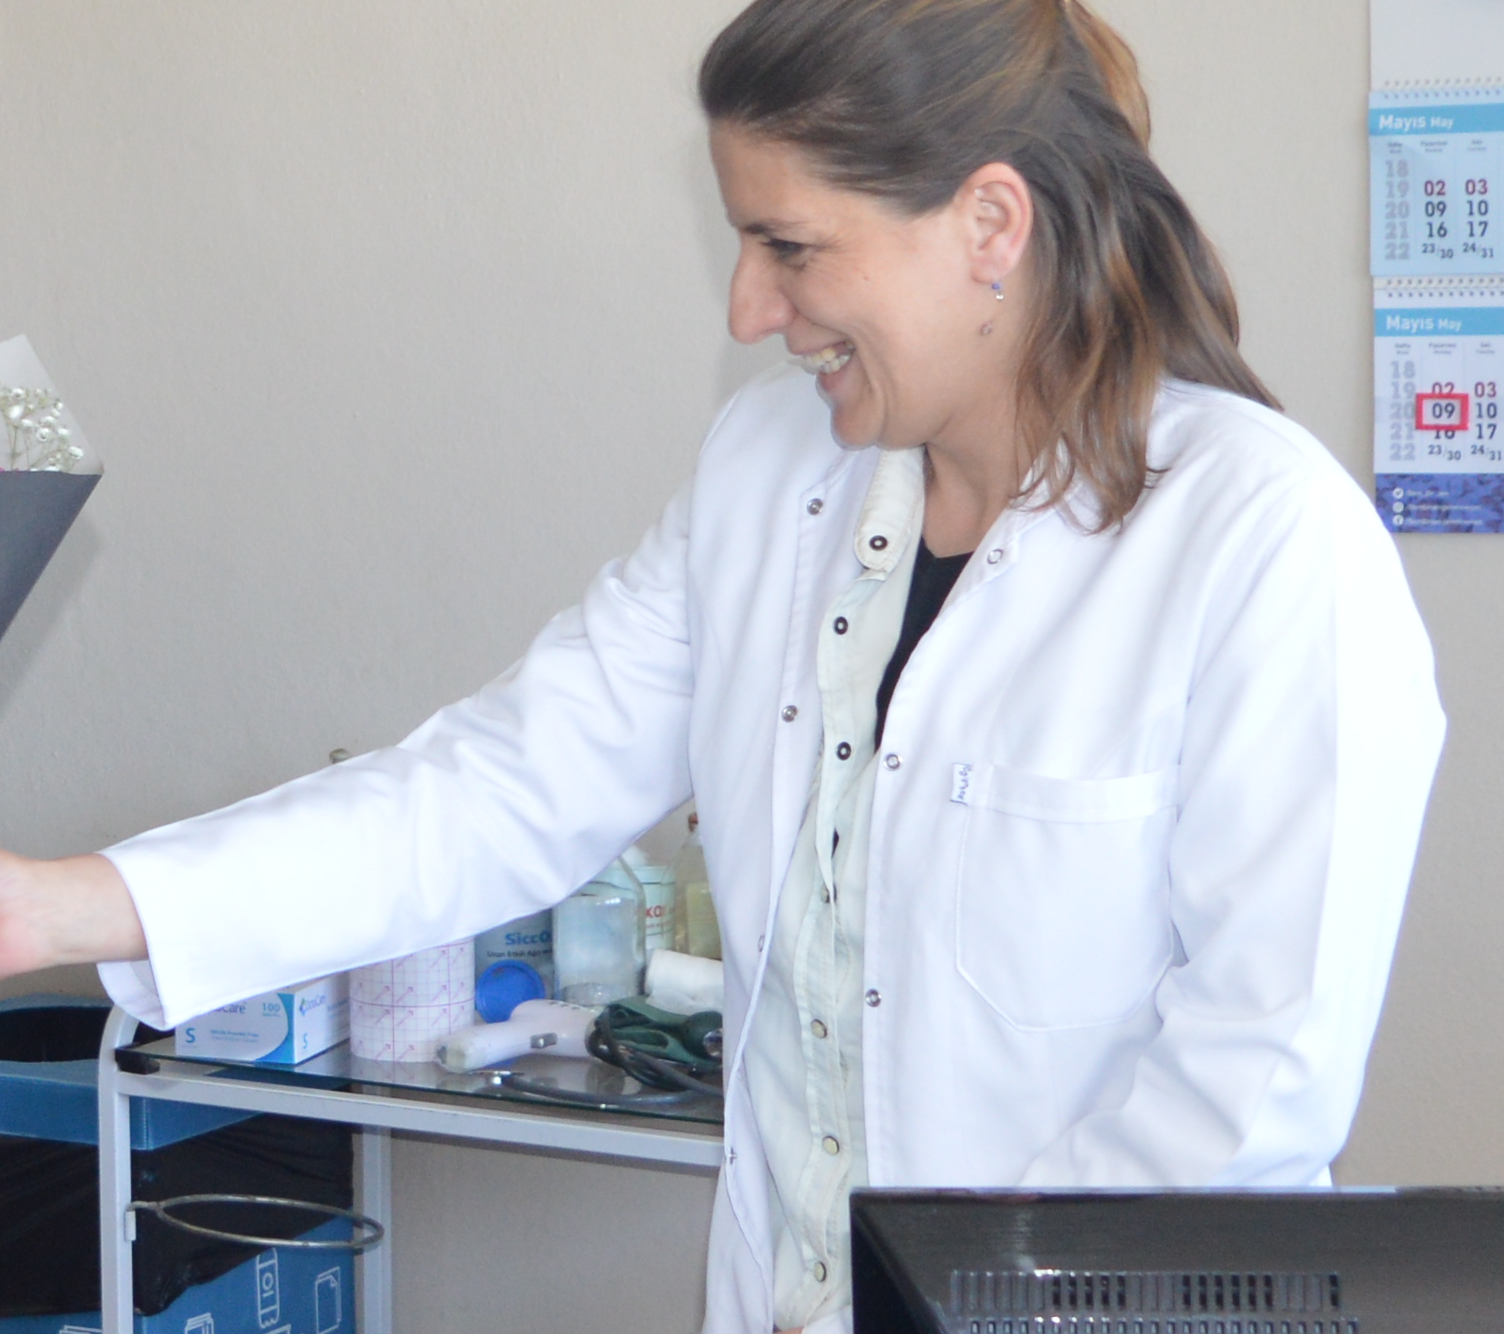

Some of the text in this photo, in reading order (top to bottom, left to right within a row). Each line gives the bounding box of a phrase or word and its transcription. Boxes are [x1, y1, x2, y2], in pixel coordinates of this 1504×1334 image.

[1379, 114, 1427, 131] Mayıs
[1424, 180, 1445, 196] 02
[1465, 179, 1487, 195] 03
[1425, 201, 1446, 217] 09
[1467, 200, 1488, 216] 10
[1428, 222, 1447, 238] 16
[1468, 221, 1488, 237] 17
[1386, 315, 1434, 333] Mayıs
[1438, 319, 1462, 331] May
[1474, 382, 1496, 398] 03
[1433, 403, 1455, 418] 09
[1477, 403, 1497, 419] 10
[1477, 423, 1497, 439] 17
[262, 1002, 281, 1012] 100
[185, 1027, 196, 1043] S
